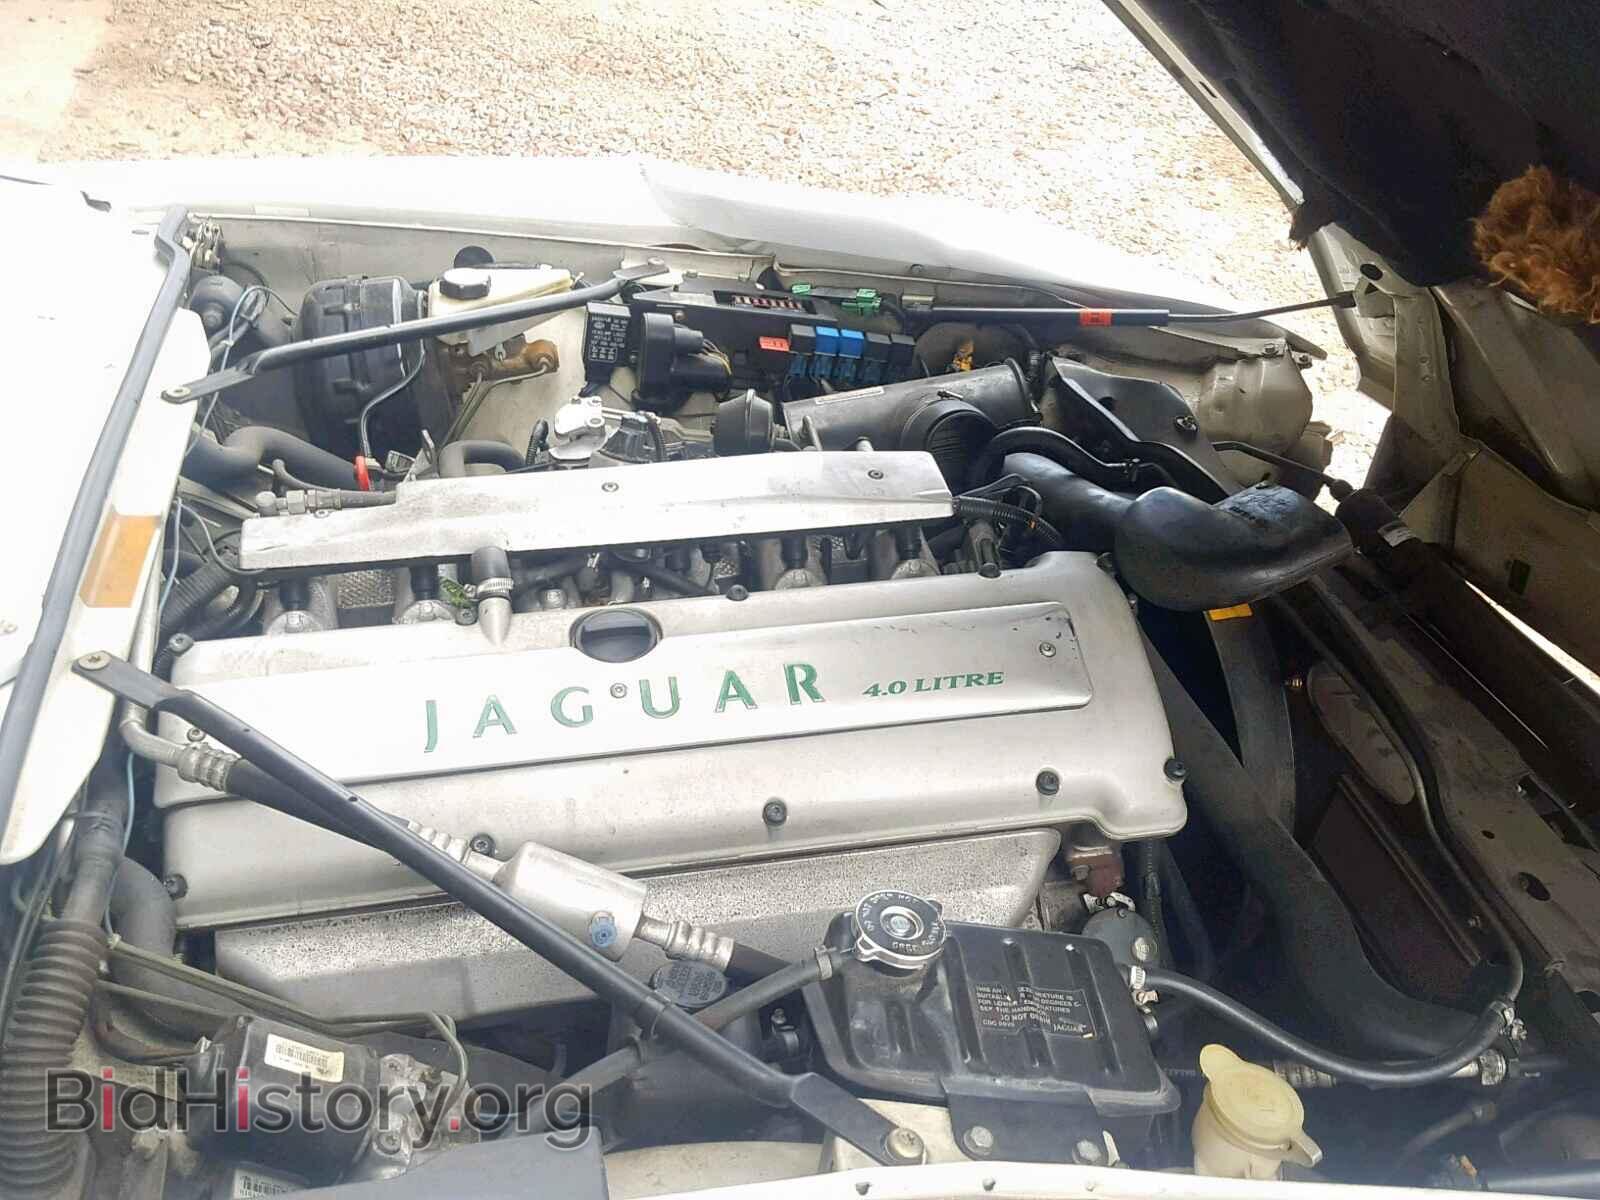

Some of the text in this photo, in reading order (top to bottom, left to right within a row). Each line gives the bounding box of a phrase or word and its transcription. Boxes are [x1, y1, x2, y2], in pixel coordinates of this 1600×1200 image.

[862, 671, 1004, 697] 4.0 LITRE
[424, 663, 825, 753] JAGUAR
[1053, 1023, 1087, 1034] JAGUAR
